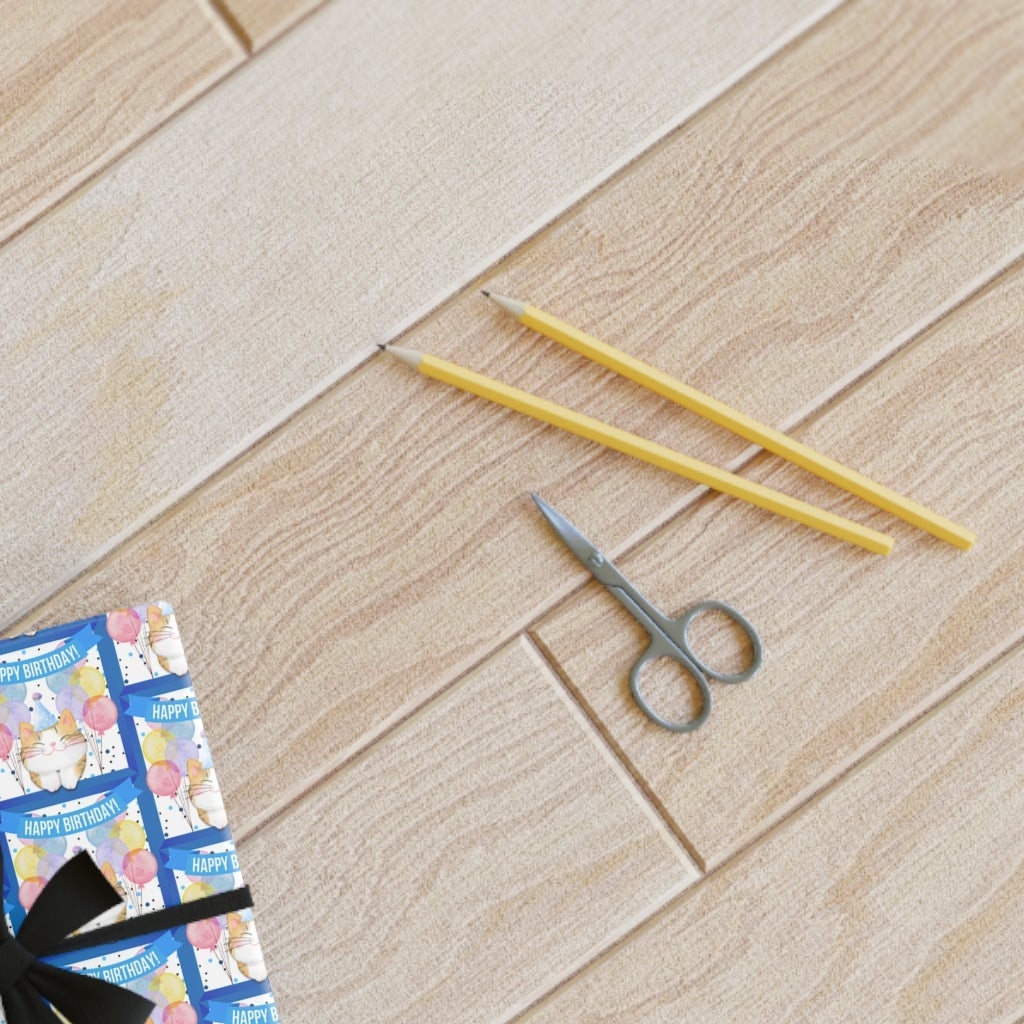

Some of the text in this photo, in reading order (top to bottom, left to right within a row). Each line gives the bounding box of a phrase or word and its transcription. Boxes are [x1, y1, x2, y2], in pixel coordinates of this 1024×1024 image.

[22, 645, 80, 679] BIRTHDAY!
[152, 703, 188, 720] HAPPY
[24, 798, 120, 835] HAPPY BIRTHDAY!
[192, 856, 228, 872] HAPPY
[102, 951, 160, 984] BIRTHDAY!
[232, 1008, 268, 1024] HAPPY
